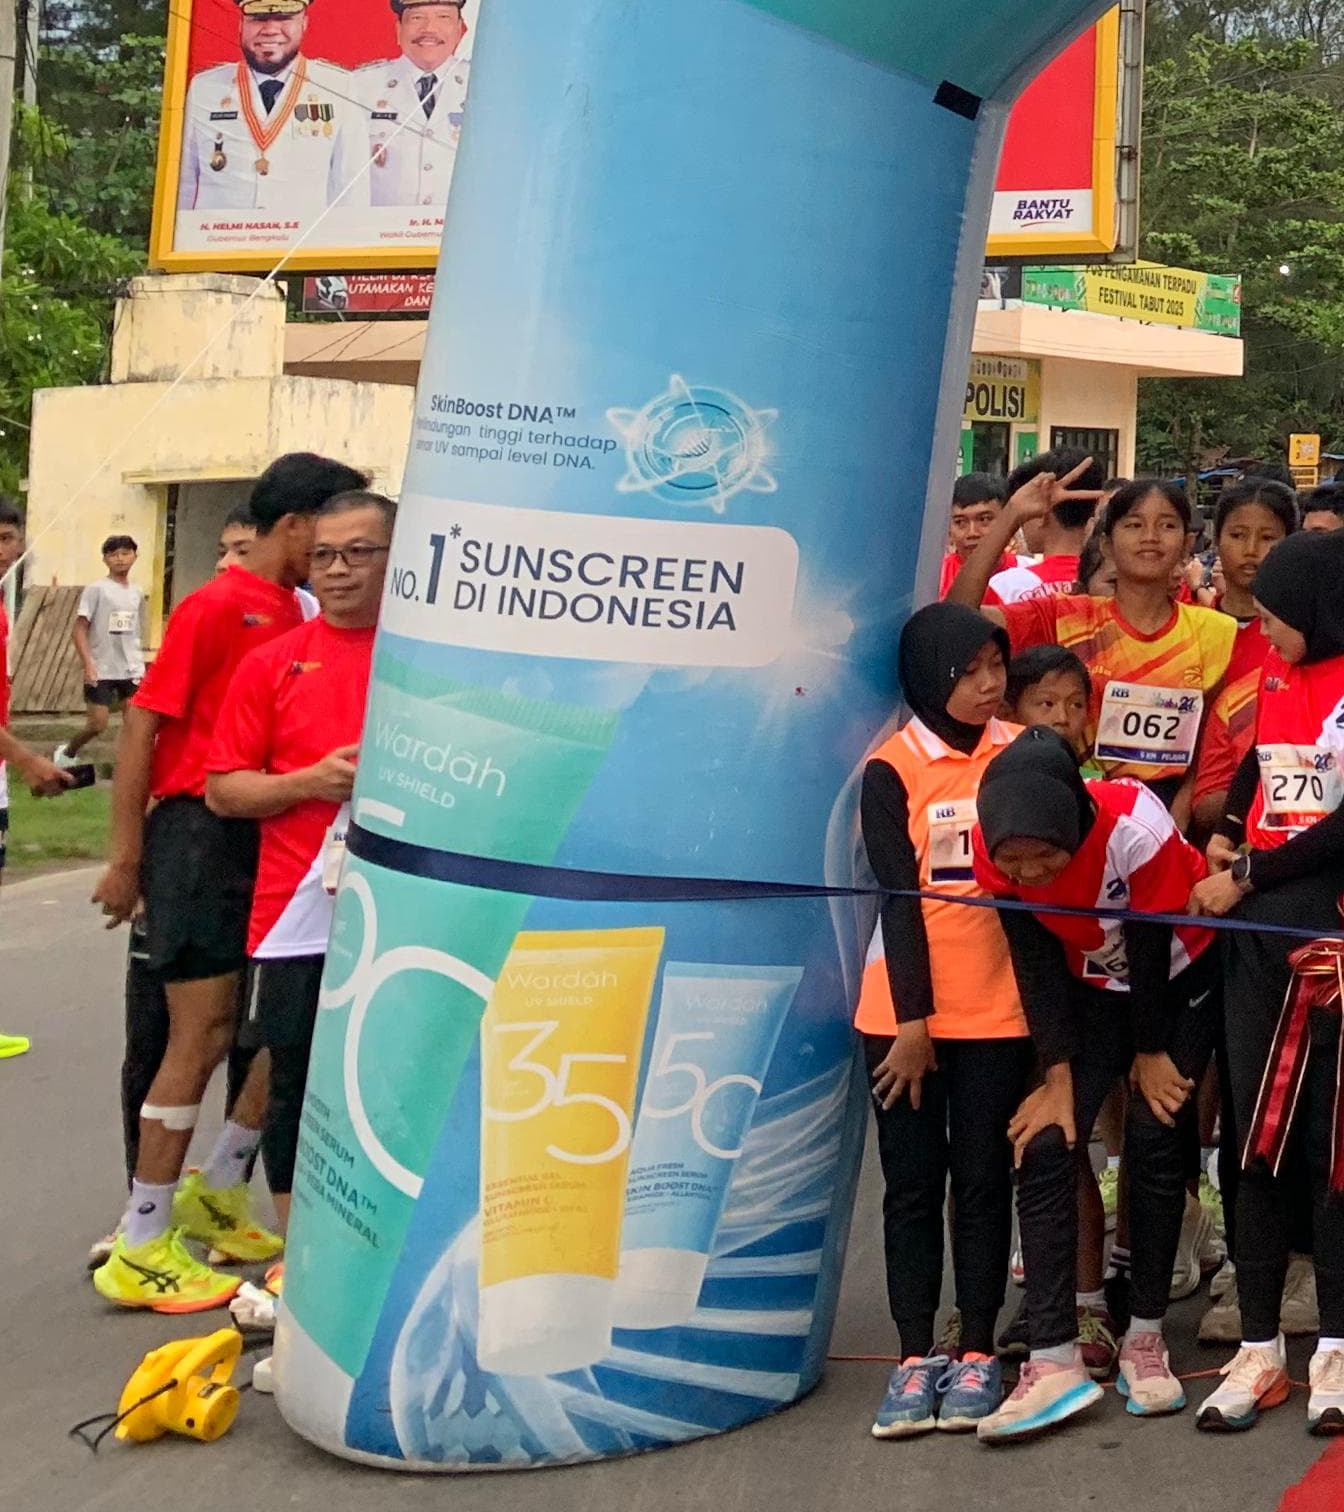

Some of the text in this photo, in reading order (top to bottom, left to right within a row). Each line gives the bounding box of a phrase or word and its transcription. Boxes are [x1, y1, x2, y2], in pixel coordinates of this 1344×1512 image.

[1012, 209, 1074, 220] RAKYAT
[1017, 199, 1071, 210] BANTU
[212, 222, 243, 230] HELMI
[348, 282, 414, 294] UTAMAKAN
[1105, 266, 1162, 289] PENGAMANAN
[1162, 273, 1196, 295] TERPADU
[404, 296, 431, 307] DAN
[1099, 286, 1137, 309] FESTIVAL
[1139, 294, 1165, 314] TABUT
[1166, 299, 1184, 316] 2025
[431, 394, 503, 419] SkinBoost
[964, 383, 1025, 419] POLISI
[479, 425, 523, 446] tinggi
[528, 430, 617, 455] terhadap
[435, 440, 449, 454] UV
[451, 445, 503, 462] sampai
[507, 450, 547, 465] level
[553, 453, 596, 470] DNA.
[459, 539, 745, 594] SUNSCREEN
[453, 580, 737, 631] DI INDONESIA
[1123, 711, 1180, 740] 062
[395, 772, 456, 809] SHIELD
[1271, 774, 1324, 801] 270
[484, 1019, 633, 1165] 35
[320, 1126, 355, 1168] SERUM
[654, 1182, 690, 1191] BOOST
[325, 1192, 380, 1249] MINERAL
[484, 1197, 540, 1217] VITAMIN
